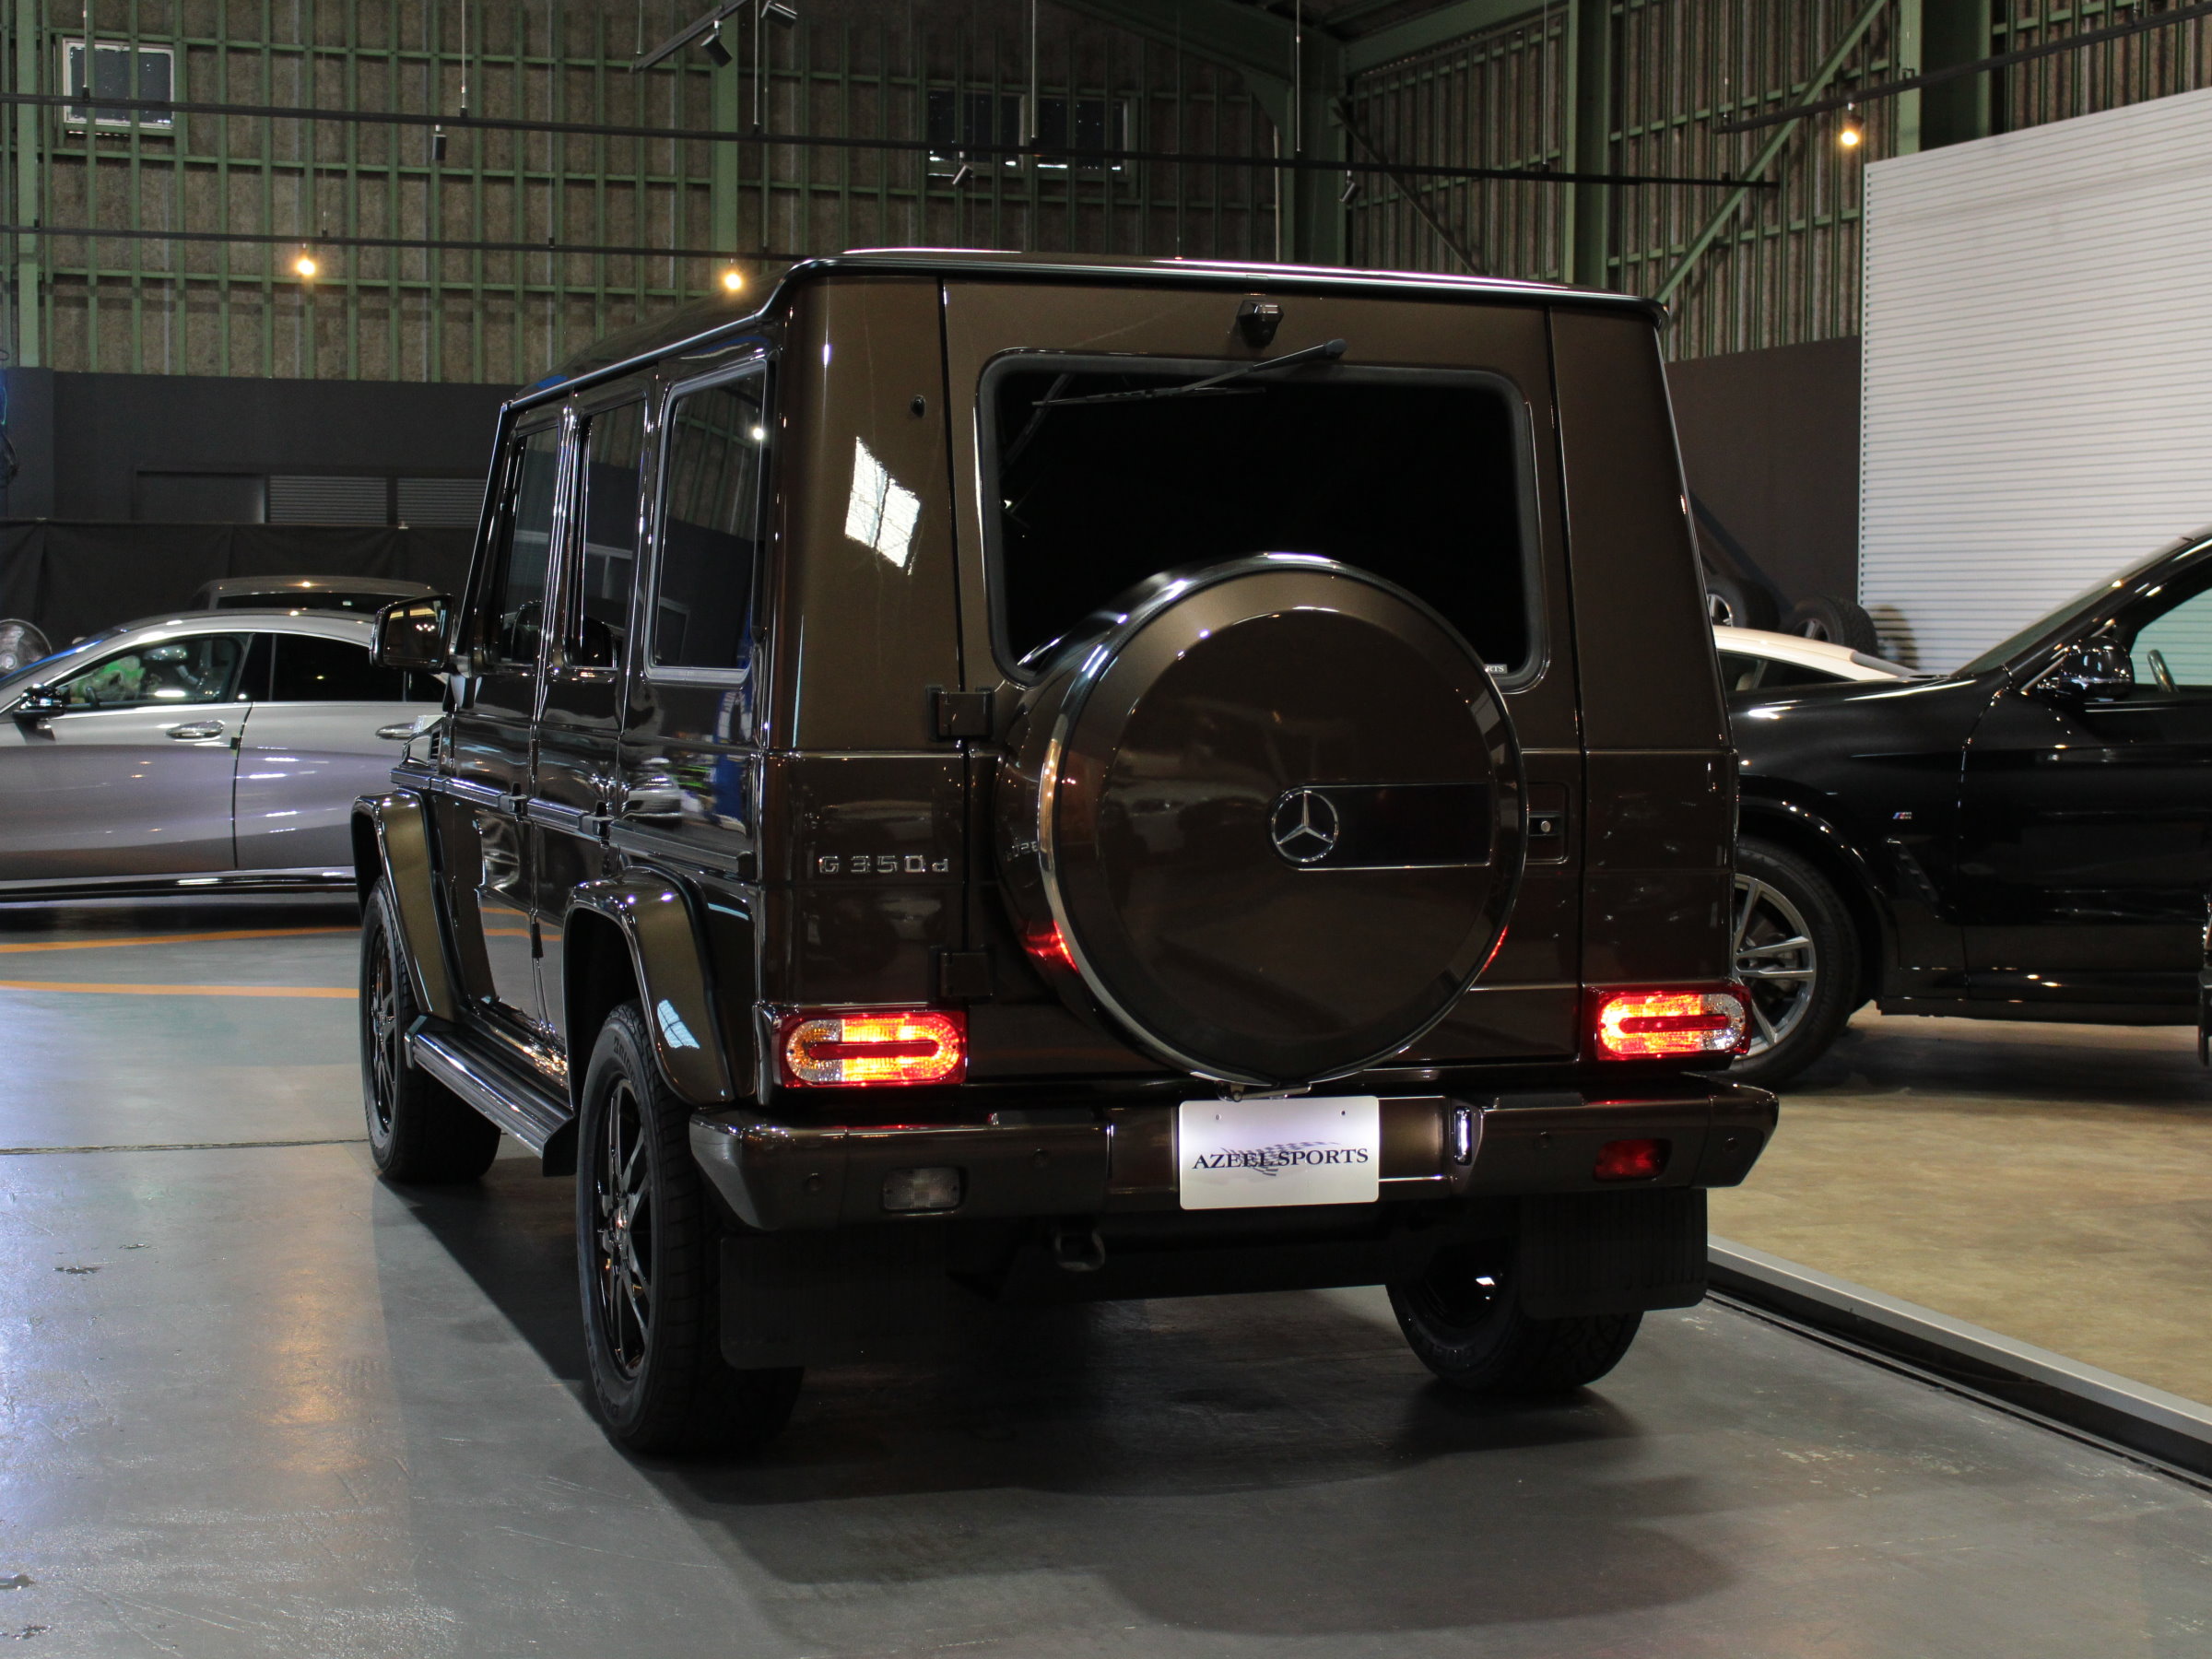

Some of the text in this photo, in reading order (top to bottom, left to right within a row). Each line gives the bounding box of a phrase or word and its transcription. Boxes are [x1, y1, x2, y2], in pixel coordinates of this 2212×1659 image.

[818, 855, 840, 873] G
[1192, 1148, 1369, 1170] AZEEL SPORTS
